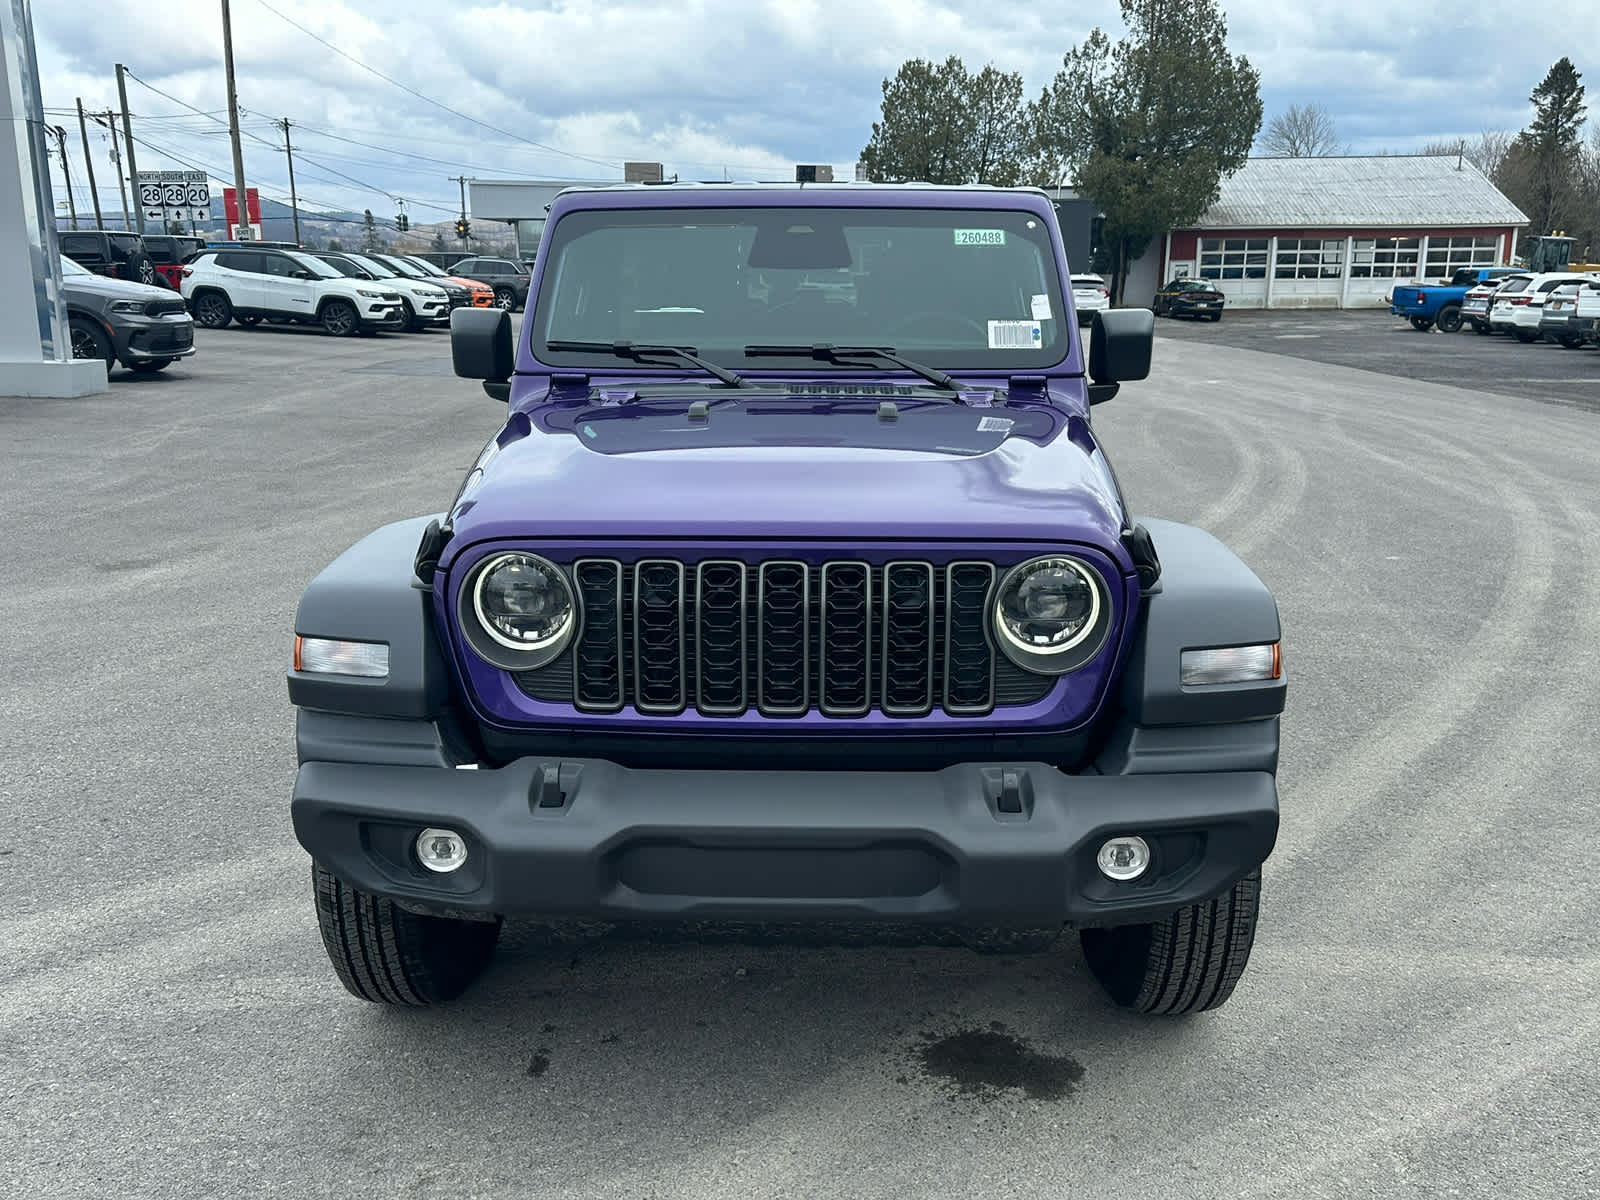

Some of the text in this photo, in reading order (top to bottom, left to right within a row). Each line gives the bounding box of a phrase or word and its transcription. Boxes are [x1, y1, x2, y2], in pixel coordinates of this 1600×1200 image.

[143, 189, 160, 201] 28
[166, 189, 184, 201] 28
[189, 189, 207, 201] 20
[961, 231, 1001, 243] 260488
